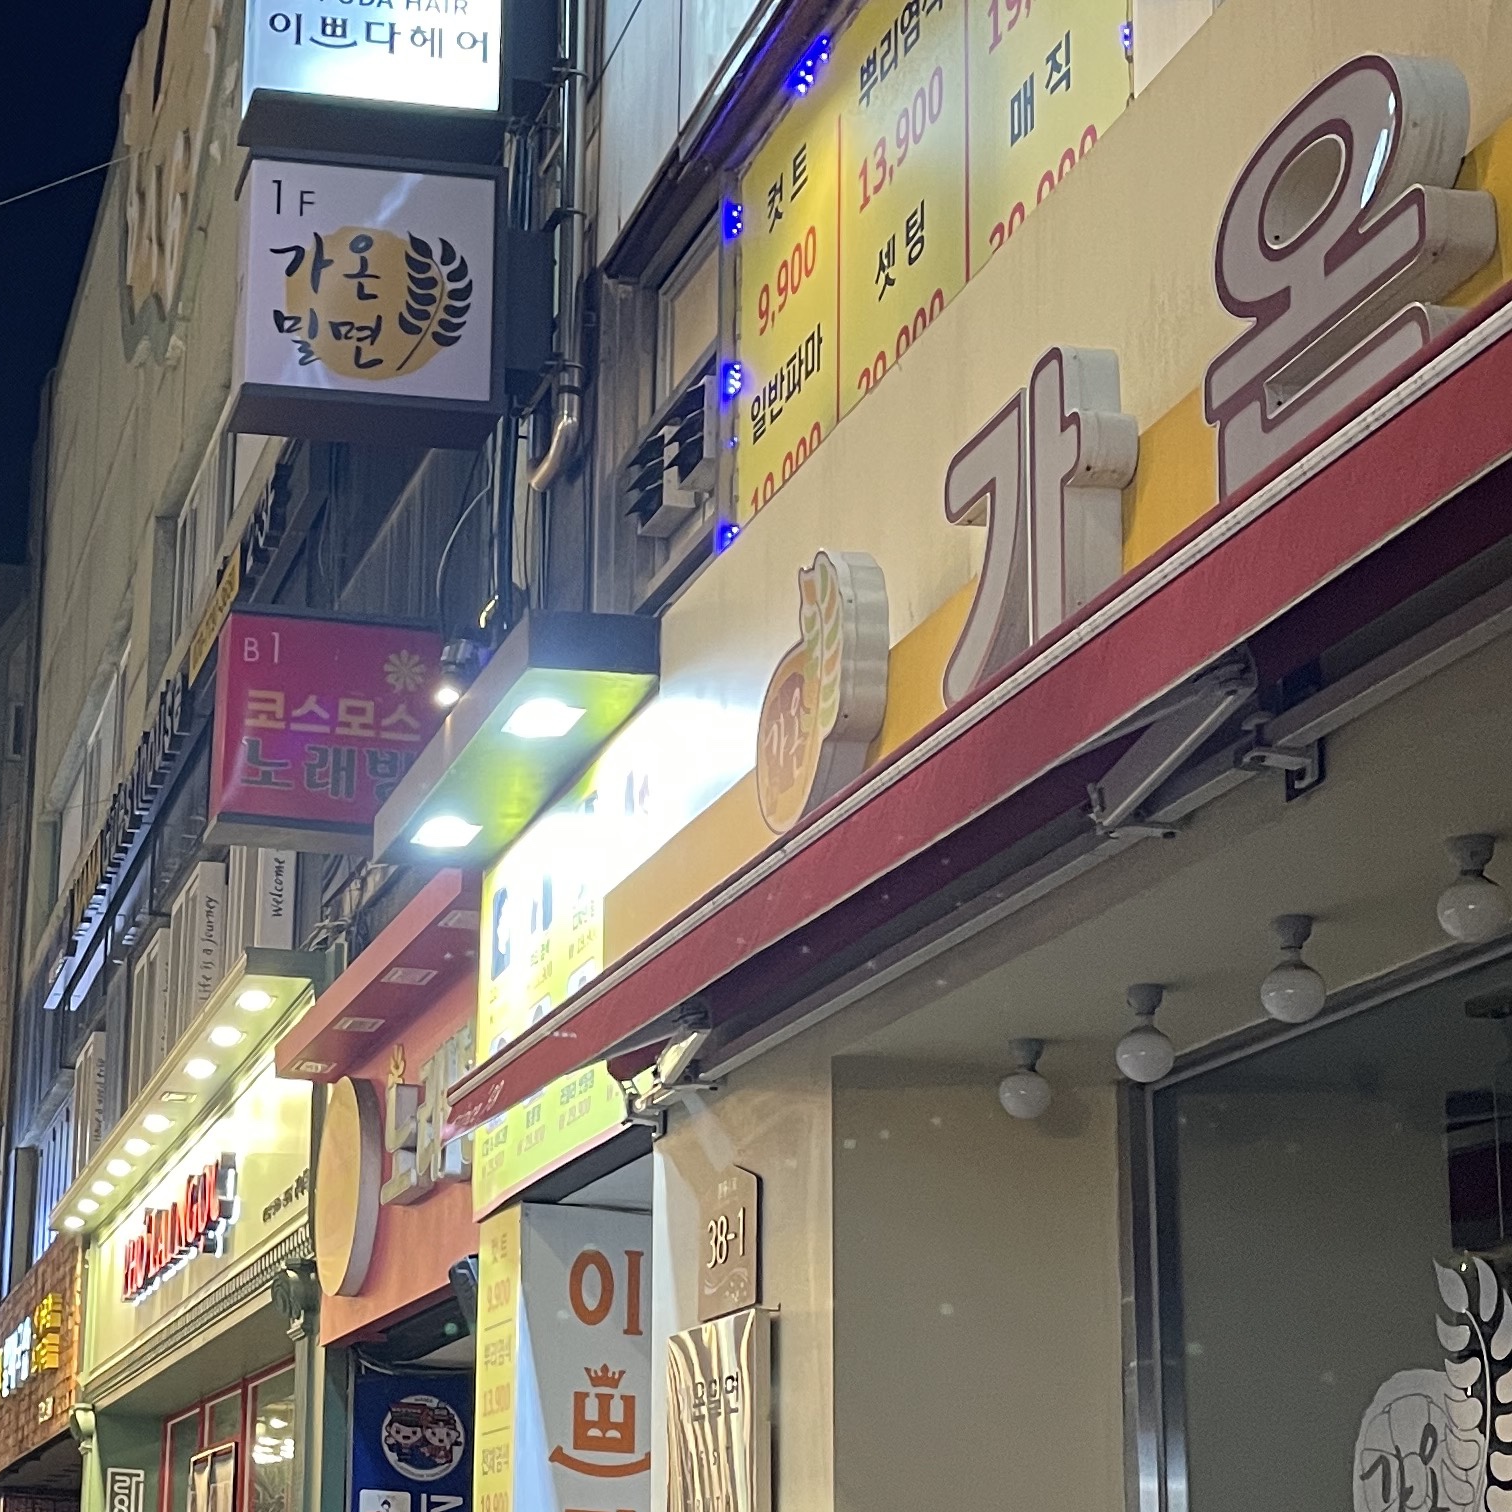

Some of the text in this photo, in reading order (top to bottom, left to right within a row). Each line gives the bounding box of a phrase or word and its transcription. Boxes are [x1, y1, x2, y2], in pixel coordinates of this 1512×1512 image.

[1010, 30, 1072, 147] 매직
[858, 66, 944, 214] 13,900
[270, 232, 380, 300] 가온
[758, 226, 817, 336] 9,900
[874, 200, 925, 301] 셋팅
[273, 308, 384, 368] 밀면
[750, 323, 823, 446] 일반파마
[244, 689, 421, 742] 코스모스
[707, 1206, 745, 1269] 38-1
